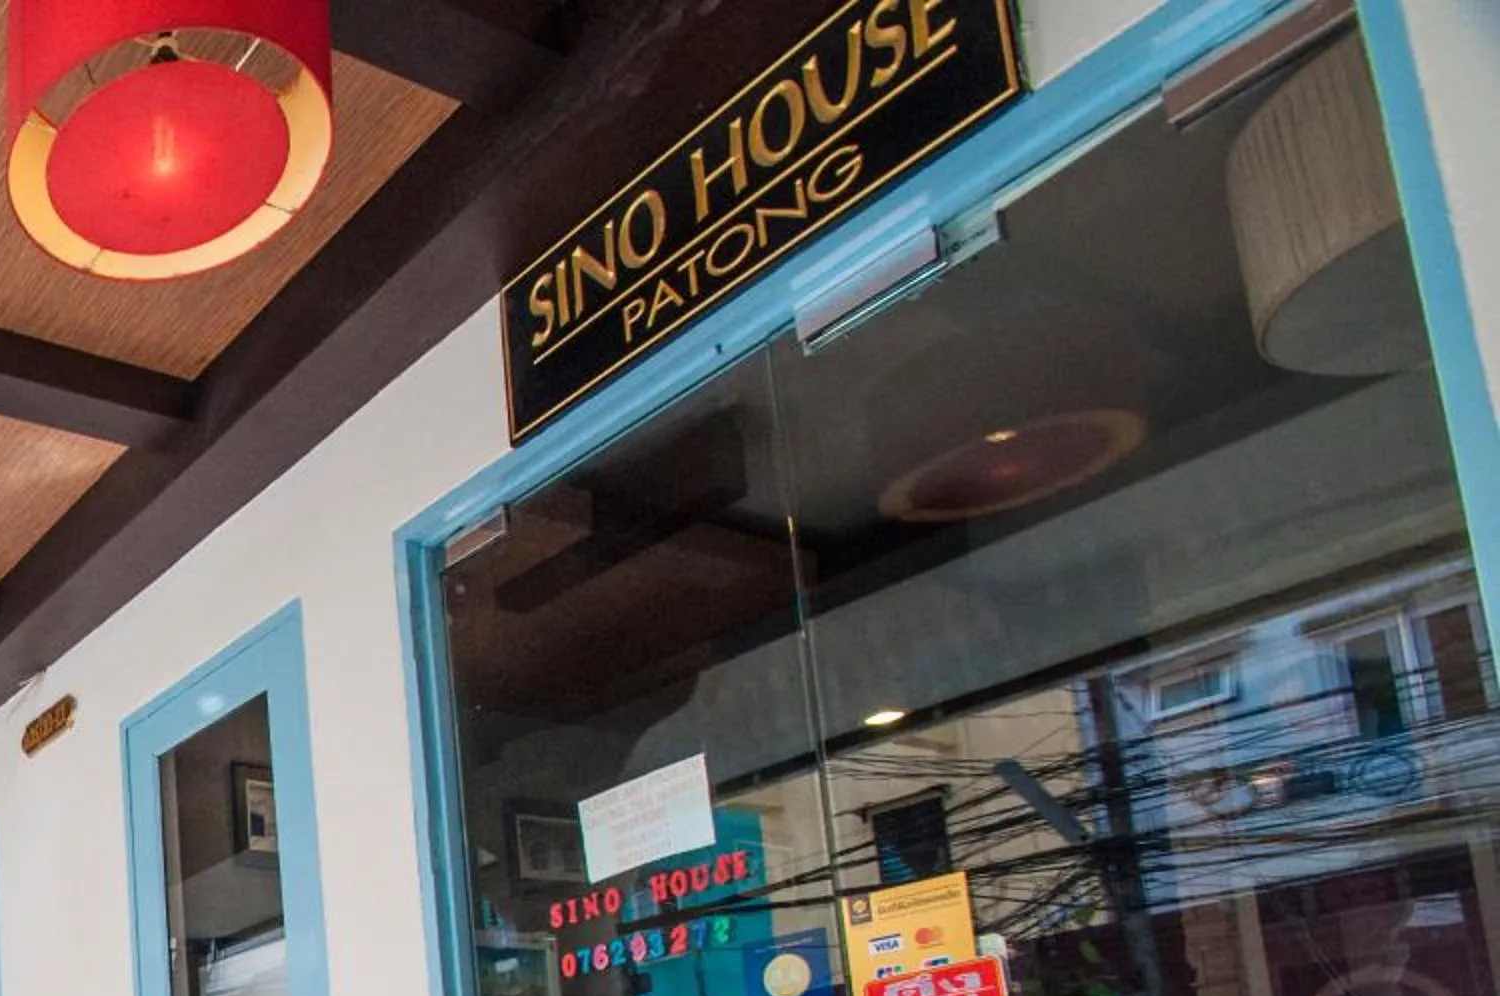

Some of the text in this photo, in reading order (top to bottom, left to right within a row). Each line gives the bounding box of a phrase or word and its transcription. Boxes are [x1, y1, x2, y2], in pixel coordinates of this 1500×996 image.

[530, 0, 959, 347] SINO HOUSE
[622, 144, 864, 343] PATONG
[550, 850, 747, 928] SINO HOUSE
[874, 939, 899, 952] VISA
